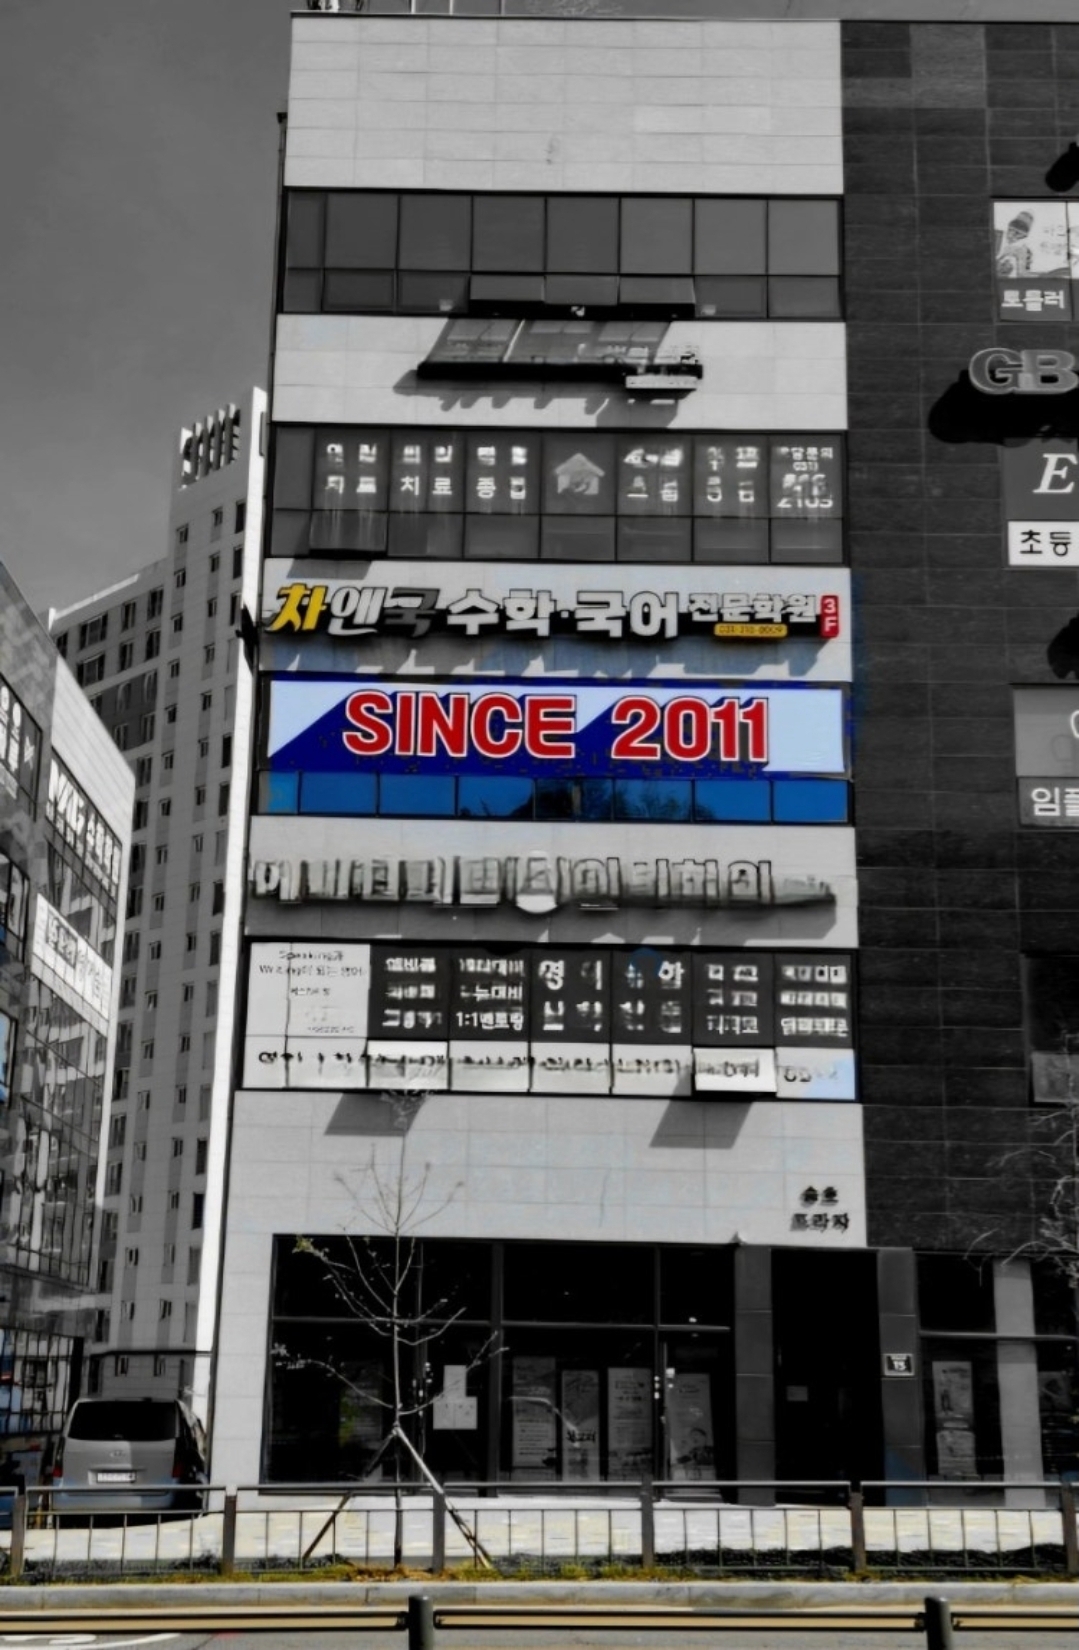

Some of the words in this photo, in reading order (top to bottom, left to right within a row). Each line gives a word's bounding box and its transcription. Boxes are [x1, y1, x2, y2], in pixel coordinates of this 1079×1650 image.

[1020, 530, 1071, 557] 초등
[688, 592, 816, 623] 전문학원
[342, 688, 577, 758] SINCE
[611, 695, 769, 762] 2011
